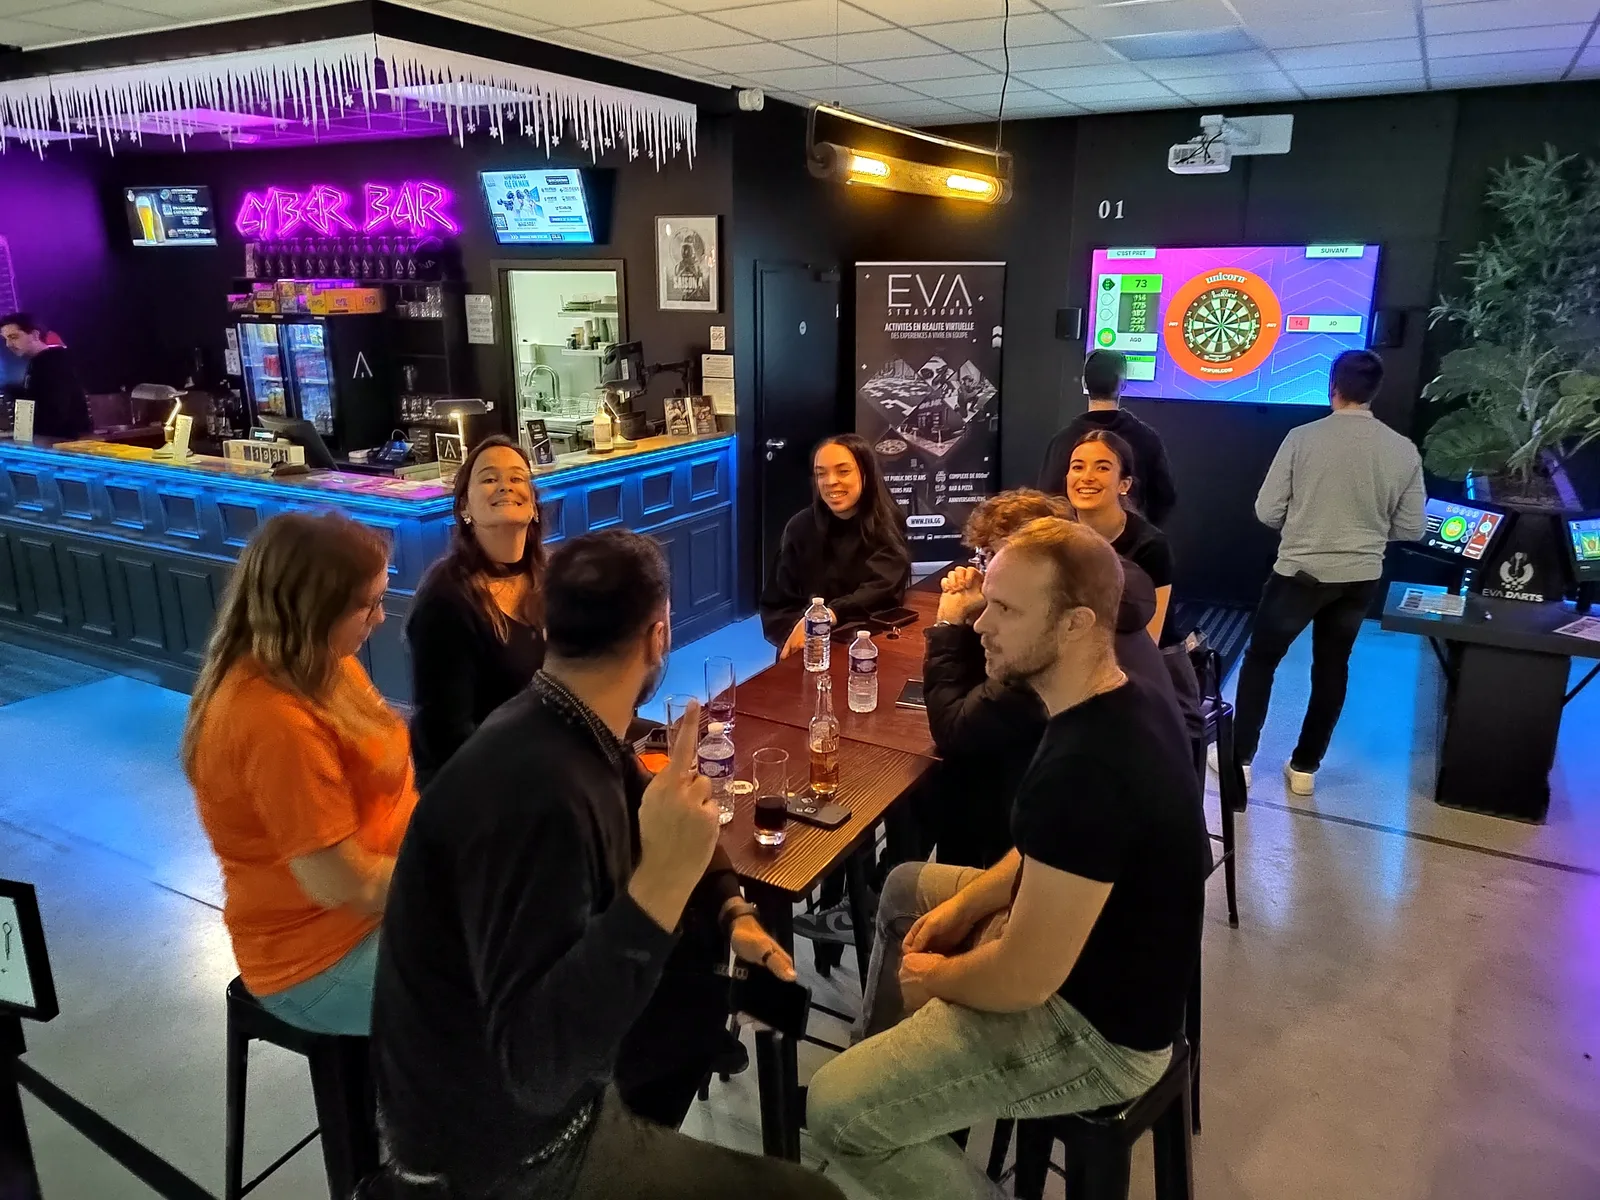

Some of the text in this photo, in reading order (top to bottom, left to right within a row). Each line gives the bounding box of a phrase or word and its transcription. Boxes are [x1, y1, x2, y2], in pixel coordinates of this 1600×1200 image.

[235, 181, 458, 240] CYBER BAR
[1098, 200, 1125, 219] 01
[888, 274, 973, 307] EVA
[1135, 279, 1148, 288] 73
[888, 308, 973, 316] STRASBOURG
[913, 322, 921, 331] EN
[1482, 588, 1544, 602] EVA DARTS
